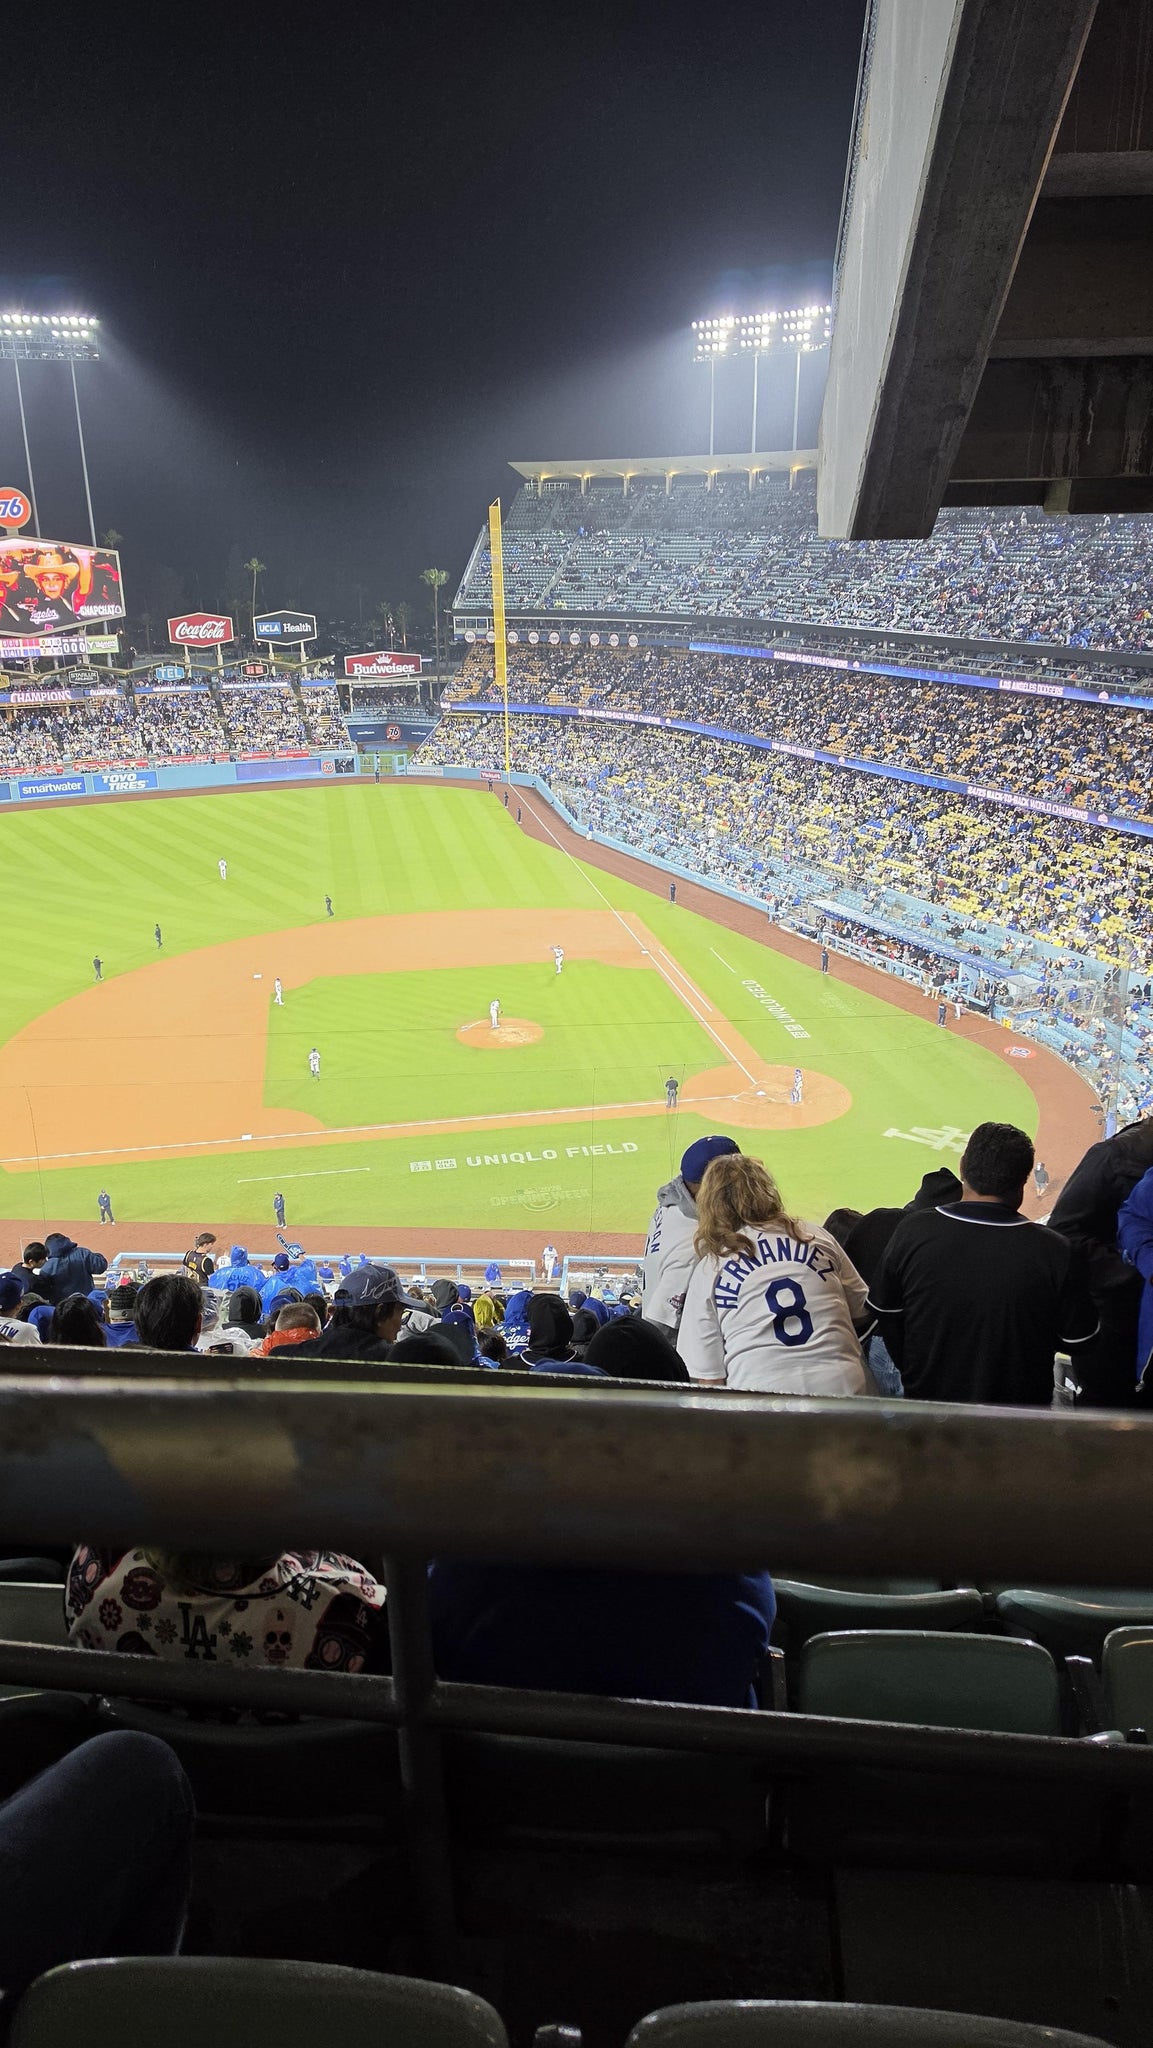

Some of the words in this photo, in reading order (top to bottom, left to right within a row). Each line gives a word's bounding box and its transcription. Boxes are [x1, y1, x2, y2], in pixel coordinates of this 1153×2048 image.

[0, 496, 24, 518] 76
[259, 624, 279, 633] UCLA
[283, 623, 312, 633] Health
[159, 668, 182, 679] TEL
[1011, 681, 1037, 692] ANGELES
[1037, 683, 1064, 695] DODGERS
[10, 690, 72, 703] CHAMPIONS
[389, 727, 400, 737] 76
[102, 773, 137, 784] TOYO
[108, 780, 146, 791] TIRES
[22, 781, 82, 795] smartwater
[1030, 798, 1052, 812] WORLD
[1052, 802, 1089, 820] CHAMPIONS
[466, 1149, 558, 1167] UNIQLO
[565, 1142, 639, 1158] FIELD
[714, 1233, 836, 1309] HERNÁNDEZ
[764, 1277, 814, 1347] 8
[177, 1602, 217, 1660] LA
